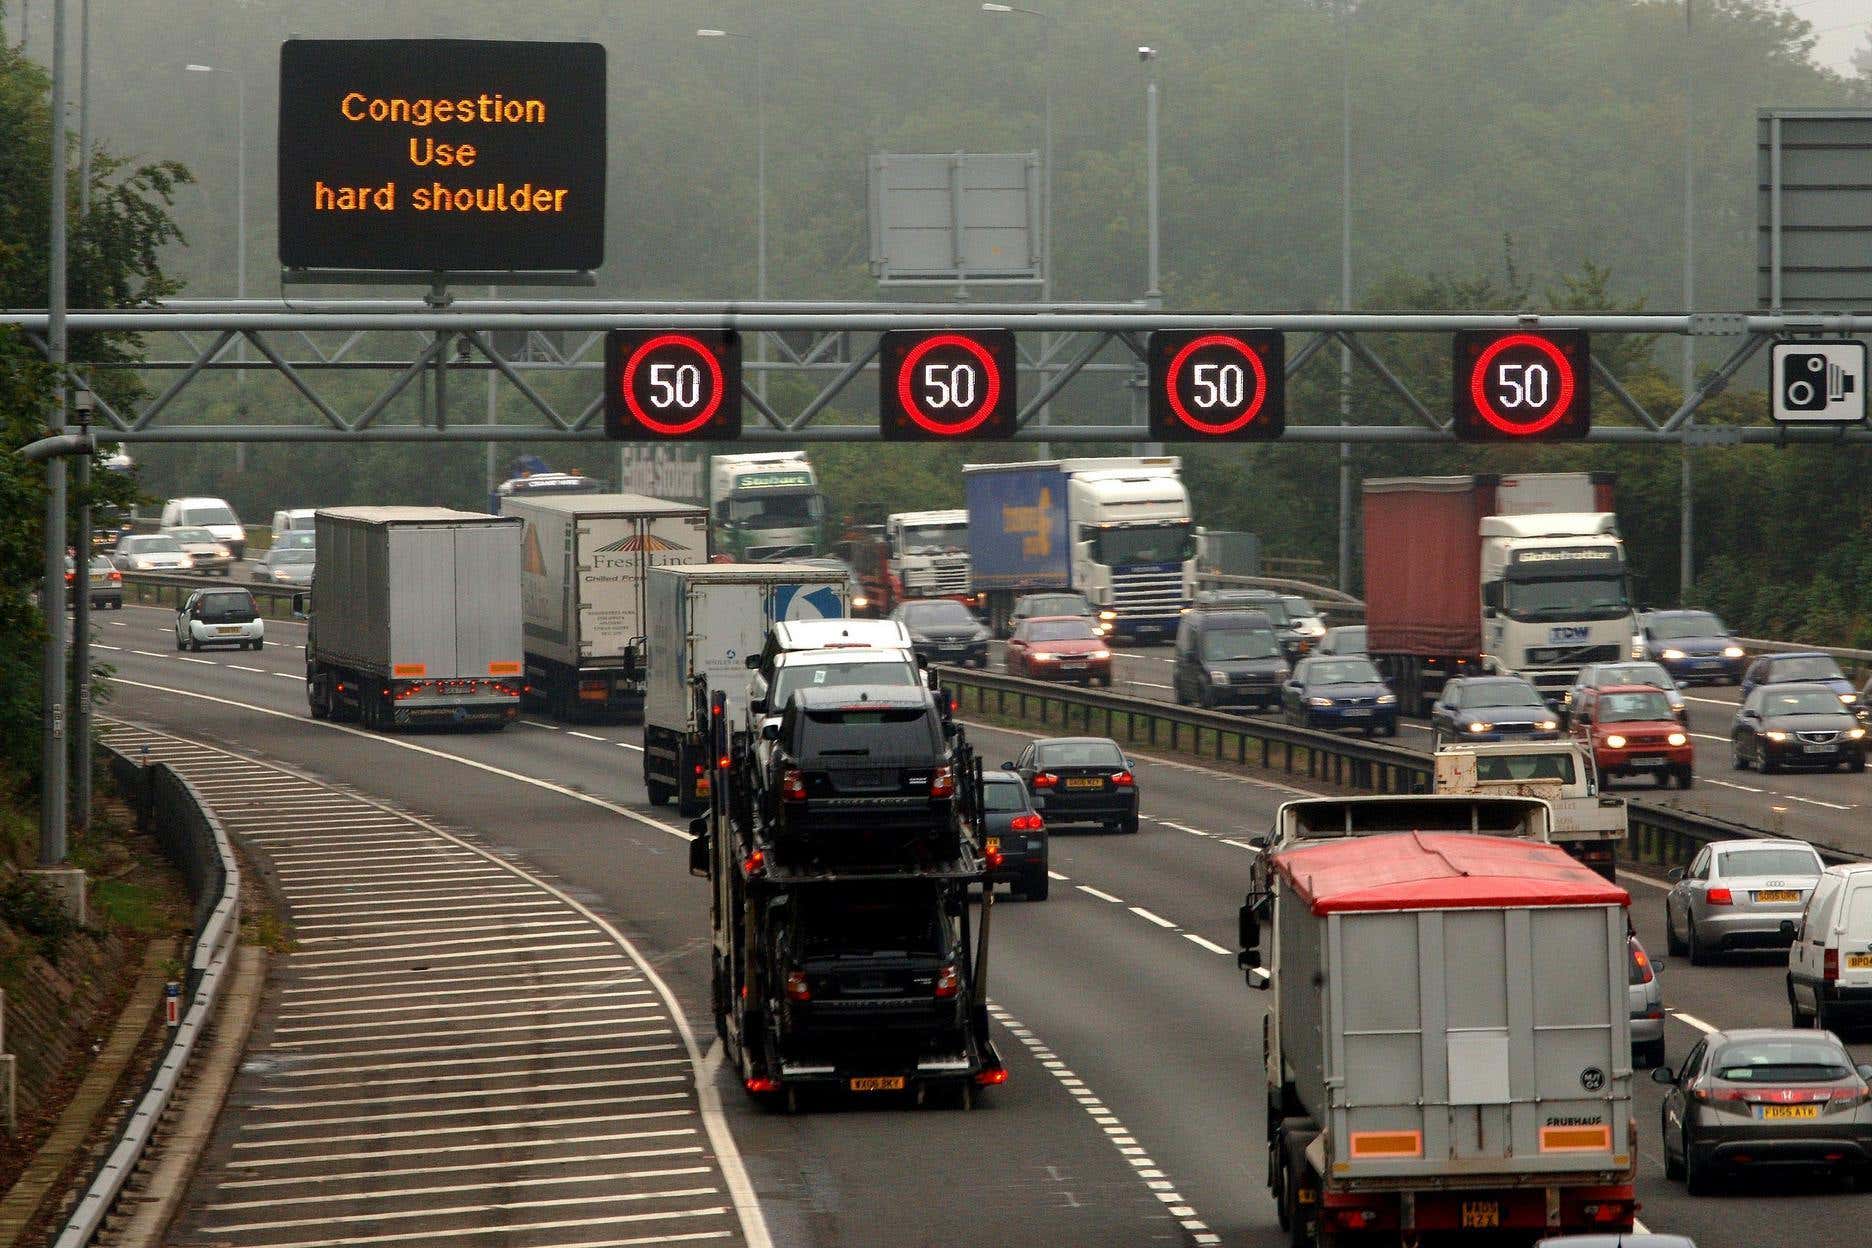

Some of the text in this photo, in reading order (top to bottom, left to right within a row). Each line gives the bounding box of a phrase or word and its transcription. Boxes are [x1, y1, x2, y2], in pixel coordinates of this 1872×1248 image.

[341, 92, 546, 127] Congestion
[409, 137, 477, 167] Use
[315, 181, 569, 212] hard shoulder
[650, 363, 701, 408] 50
[925, 364, 976, 409] 50
[1193, 363, 1244, 408] 50
[1499, 363, 1549, 408] 50
